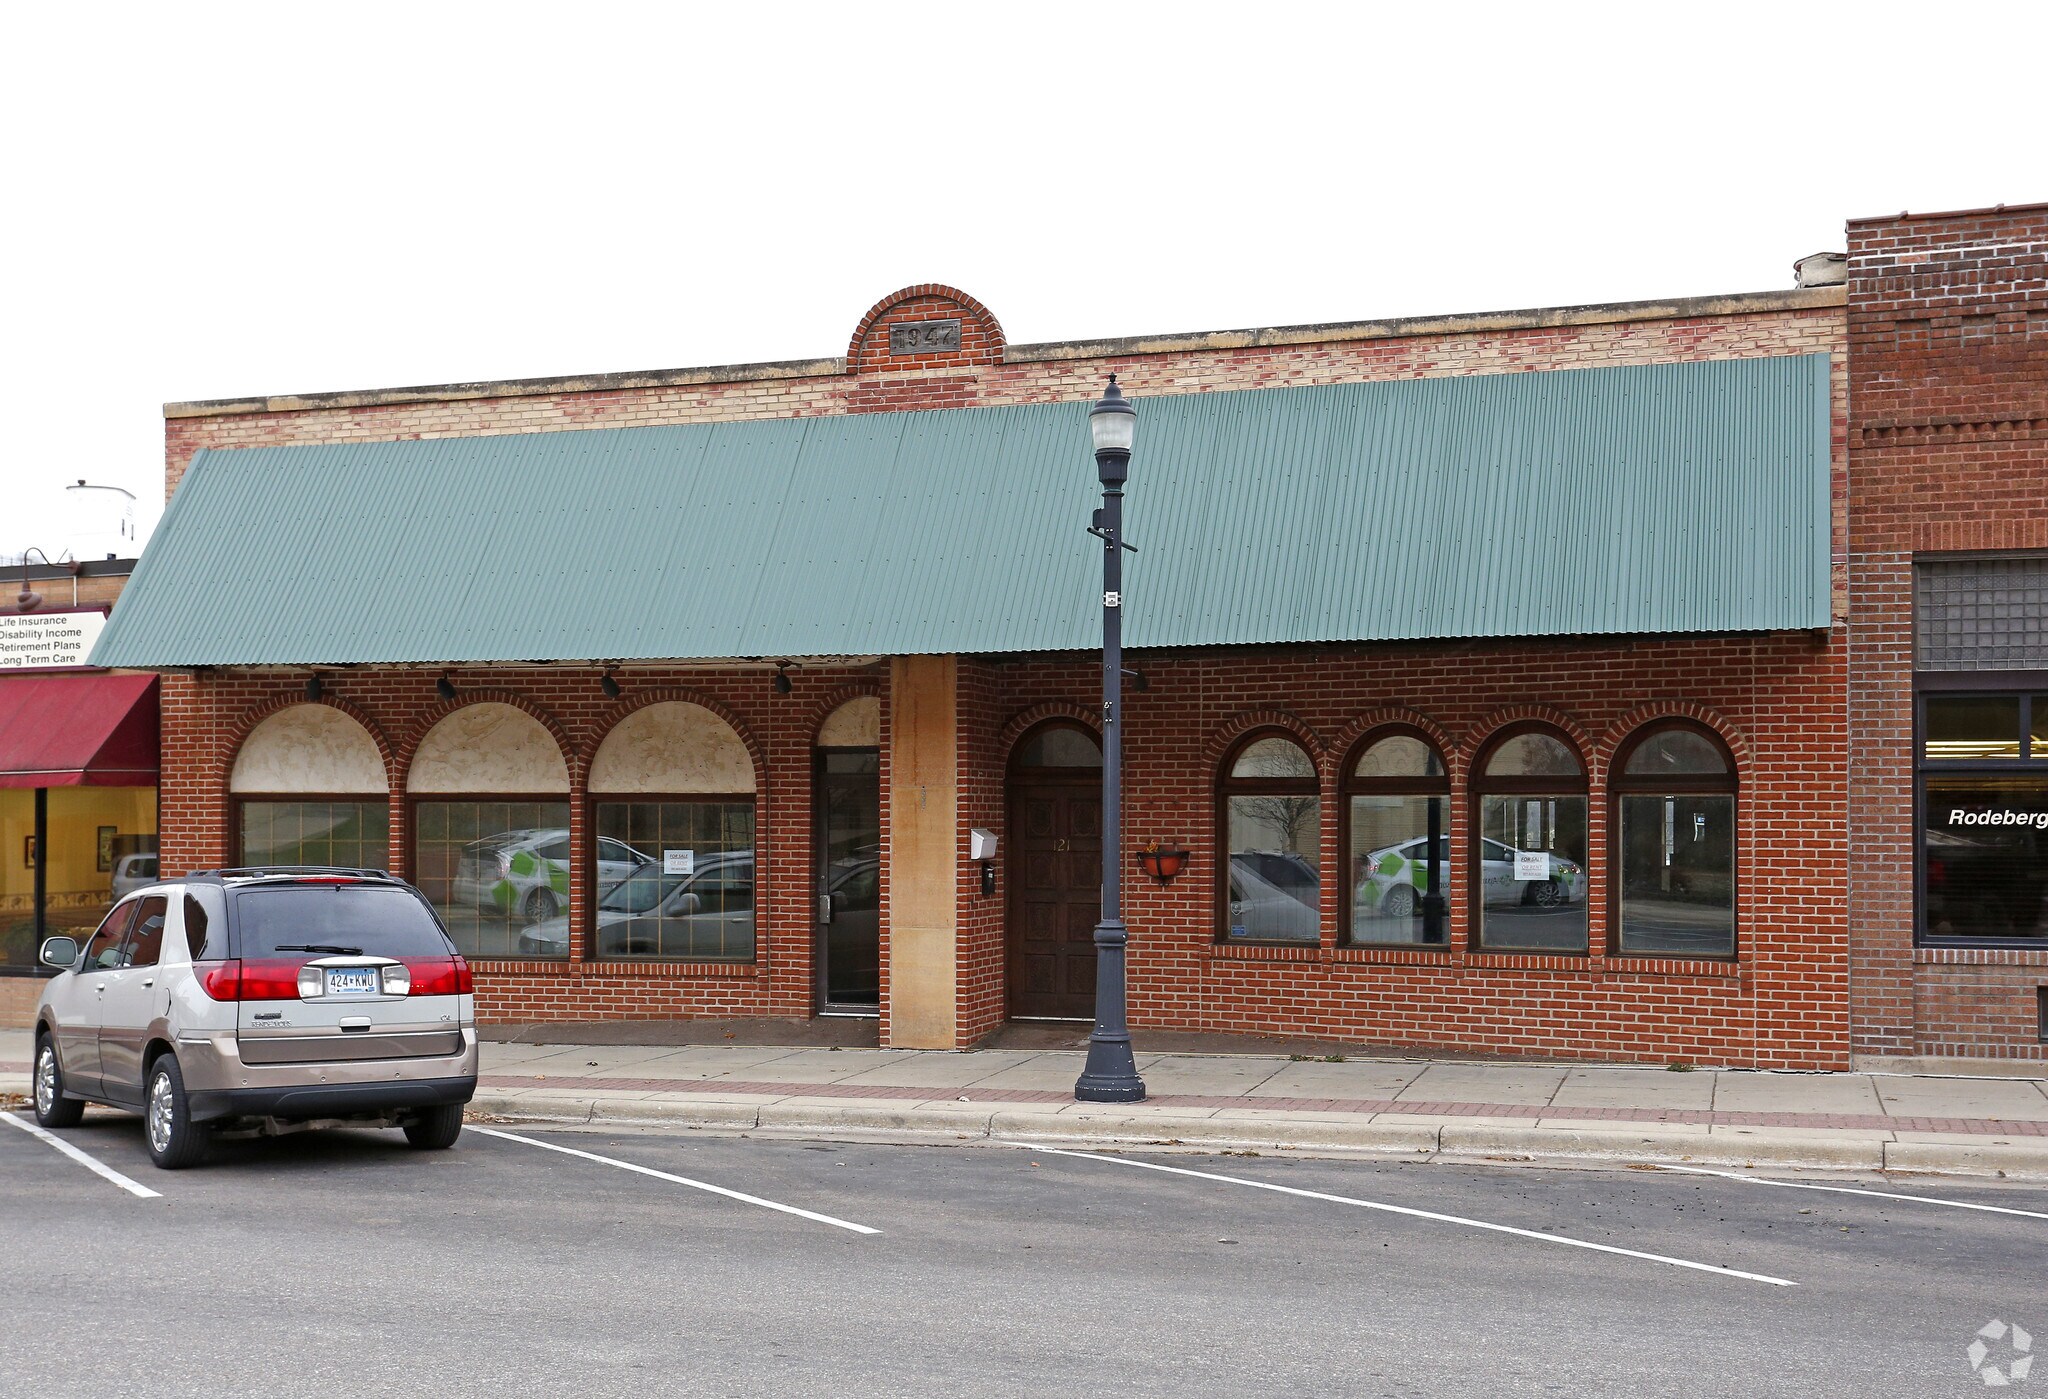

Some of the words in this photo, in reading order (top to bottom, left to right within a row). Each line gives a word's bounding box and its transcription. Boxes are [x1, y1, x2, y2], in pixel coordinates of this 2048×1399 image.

[893, 326, 954, 349] 1947
[19, 617, 67, 626] Insurance
[0, 630, 42, 640] Disability
[46, 629, 82, 638] Income
[0, 642, 51, 652] Retirement
[54, 641, 81, 650] Plans
[0, 655, 22, 667] ong
[25, 655, 50, 664] Term
[53, 654, 76, 663] Care
[1948, 809, 2048, 829] Rodeberg
[330, 975, 348, 987] 424
[355, 974, 374, 987] KWU
